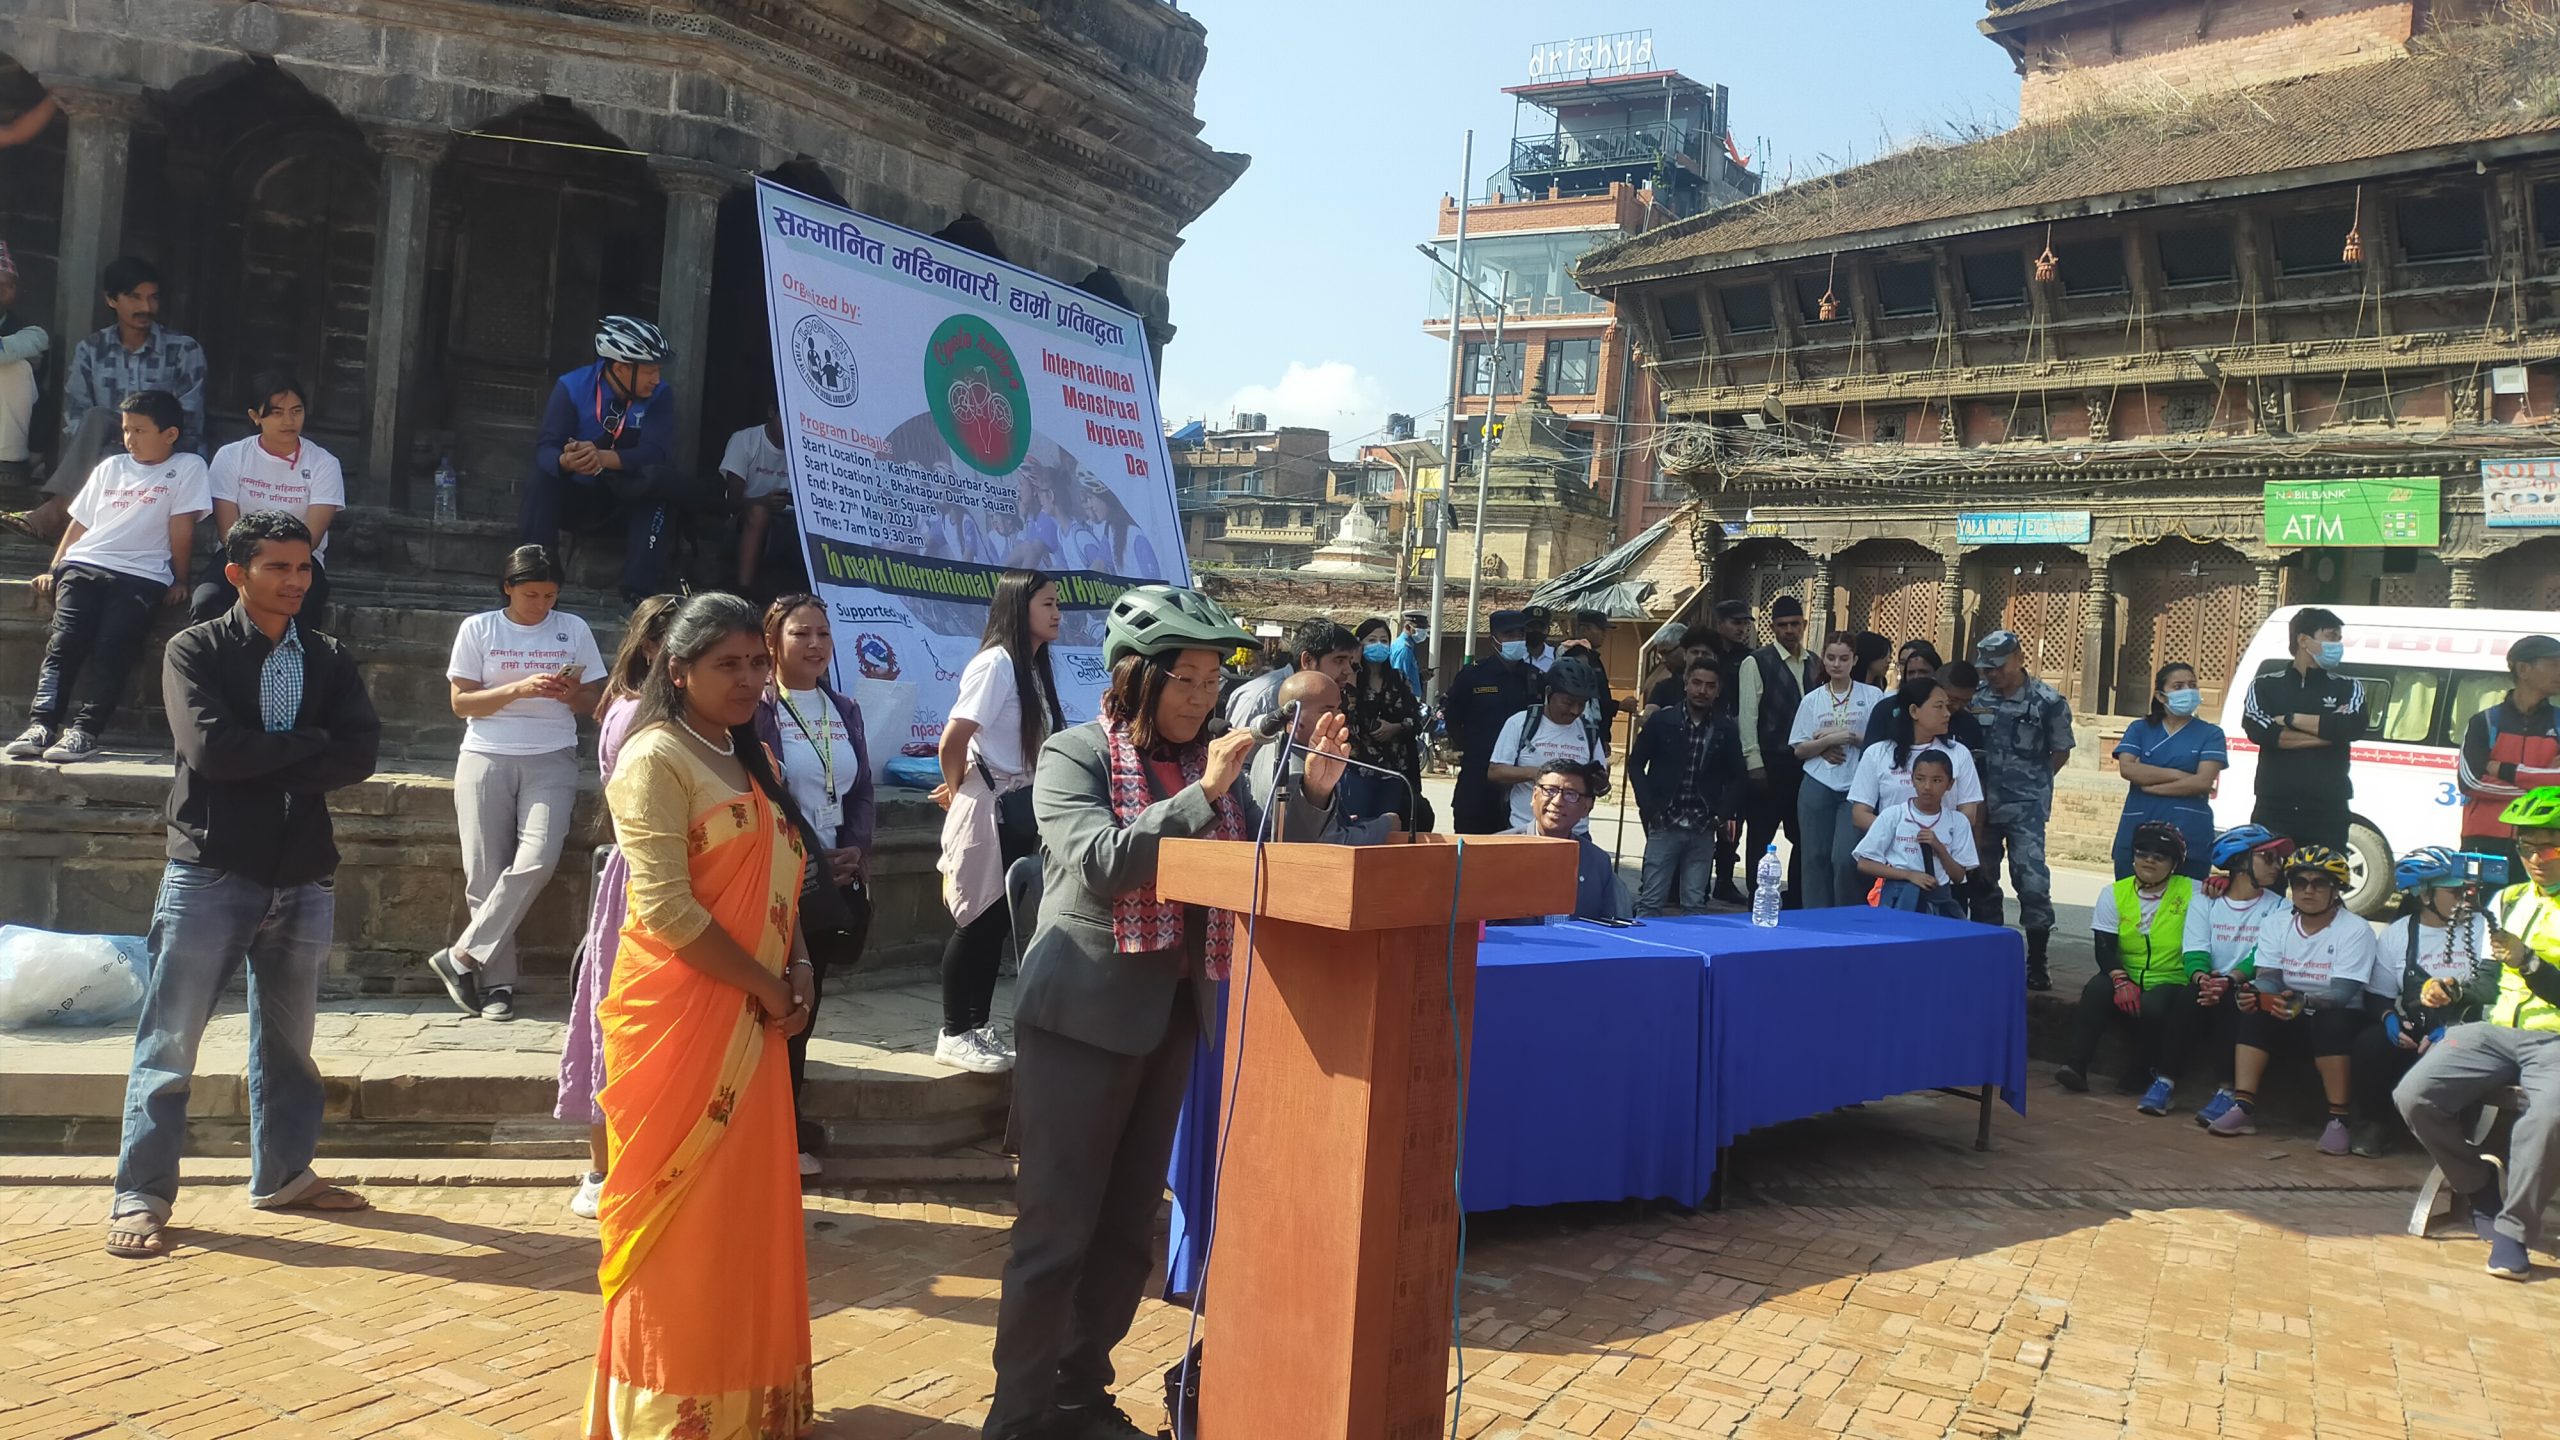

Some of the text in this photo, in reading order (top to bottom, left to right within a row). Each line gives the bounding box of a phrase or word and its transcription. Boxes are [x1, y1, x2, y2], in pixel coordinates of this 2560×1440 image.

[1528, 36, 1652, 77] drishya
[772, 206, 1124, 346] सम्मानित महिनावारी, हाम्रो प्रतिबद्धता
[841, 297, 861, 320] by:
[1042, 348, 1135, 393] International
[1062, 384, 1140, 421] Menstrual
[799, 412, 848, 437] Program
[1085, 419, 1145, 449] Hygiene
[801, 435, 826, 456] Start
[828, 444, 872, 469] Location
[887, 462, 946, 485] Kathmandu
[948, 475, 981, 492] Durbar
[984, 482, 1017, 498] Square
[1124, 453, 1149, 478] Day
[804, 455, 829, 474] Start
[831, 463, 873, 485] Location
[890, 479, 943, 501] Bhaktapur
[945, 490, 979, 507] Durbar
[982, 497, 1015, 514] Square
[806, 473, 937, 515] End: Patan Durbar Square
[810, 492, 838, 512] Date:
[861, 505, 886, 525] May,
[887, 512, 914, 528] 2023
[813, 510, 925, 547] Time: 7am to 9:30 am
[1958, 519, 1985, 536] YALA
[1987, 519, 2025, 536] MONEY
[2282, 513, 2345, 541] ATM
[821, 543, 843, 579] To
[842, 554, 889, 586] mark
[886, 556, 993, 599] International
[836, 602, 897, 620] Supported
